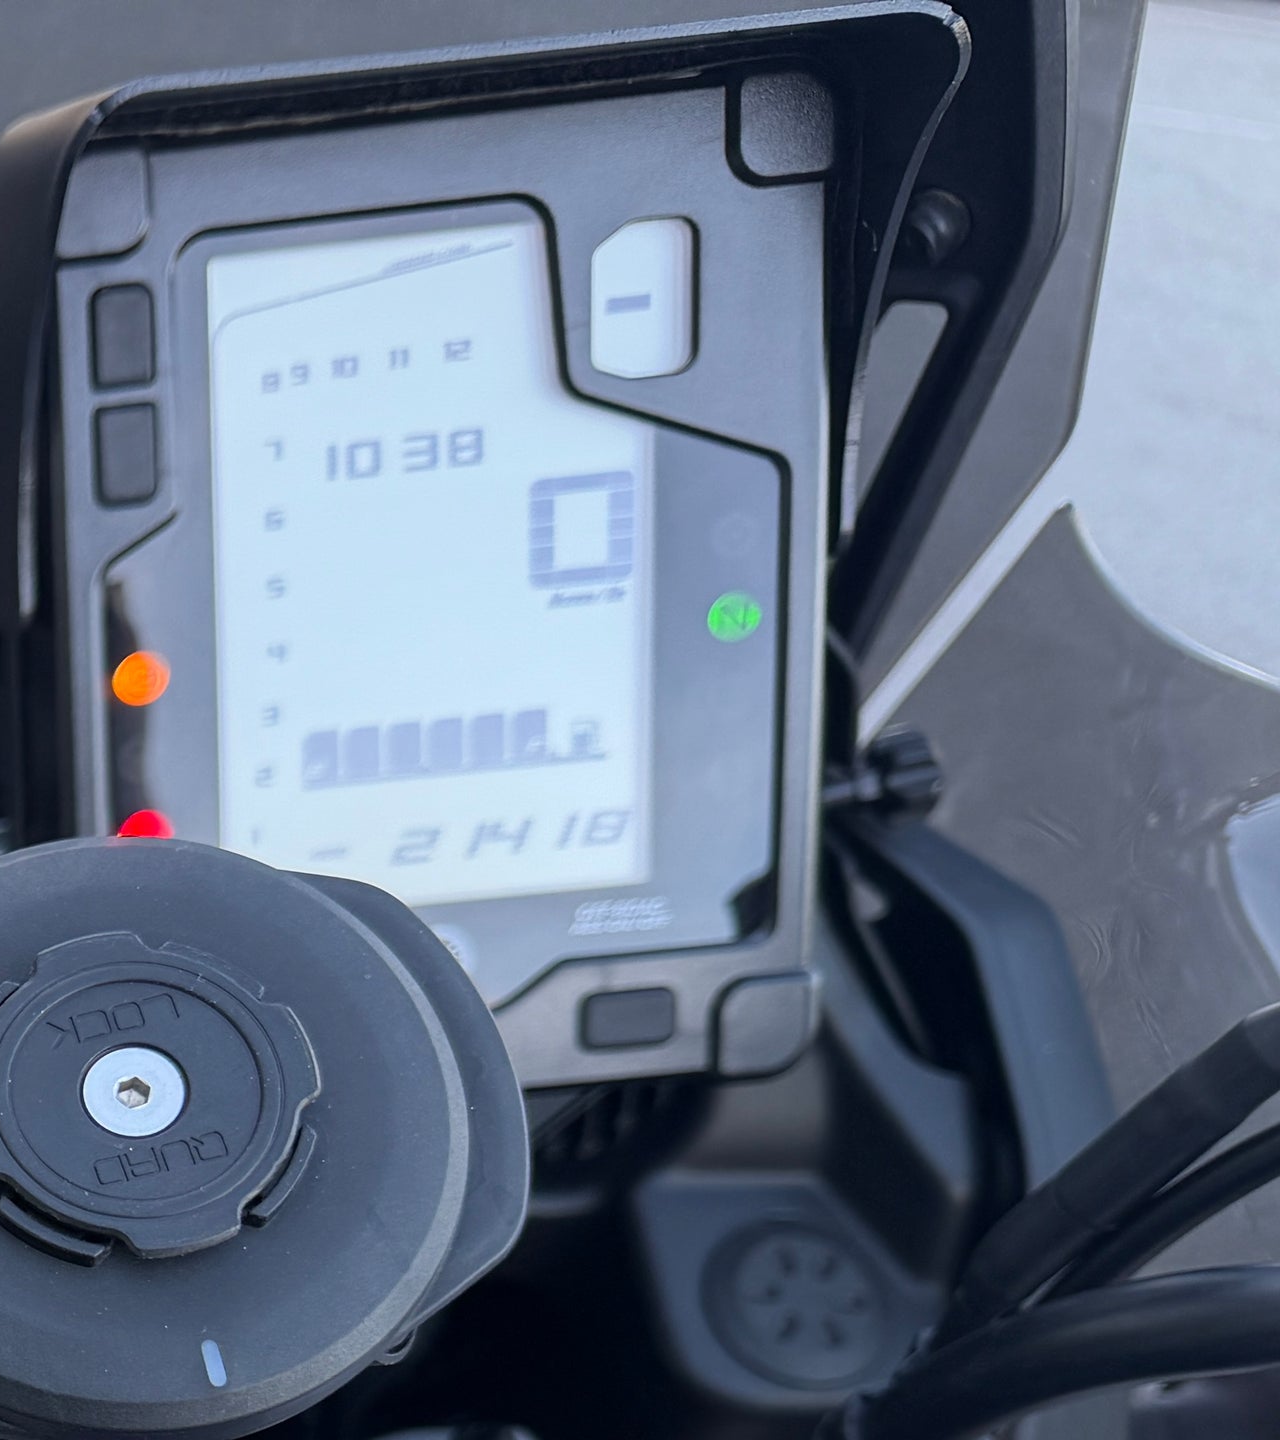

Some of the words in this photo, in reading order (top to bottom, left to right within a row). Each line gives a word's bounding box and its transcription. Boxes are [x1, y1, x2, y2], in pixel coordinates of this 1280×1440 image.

[330, 356, 359, 379] 10
[388, 347, 410, 370] 11
[443, 339, 472, 361] 12
[46, 993, 181, 1050] LOCK
[93, 1130, 229, 1186] QUAD
